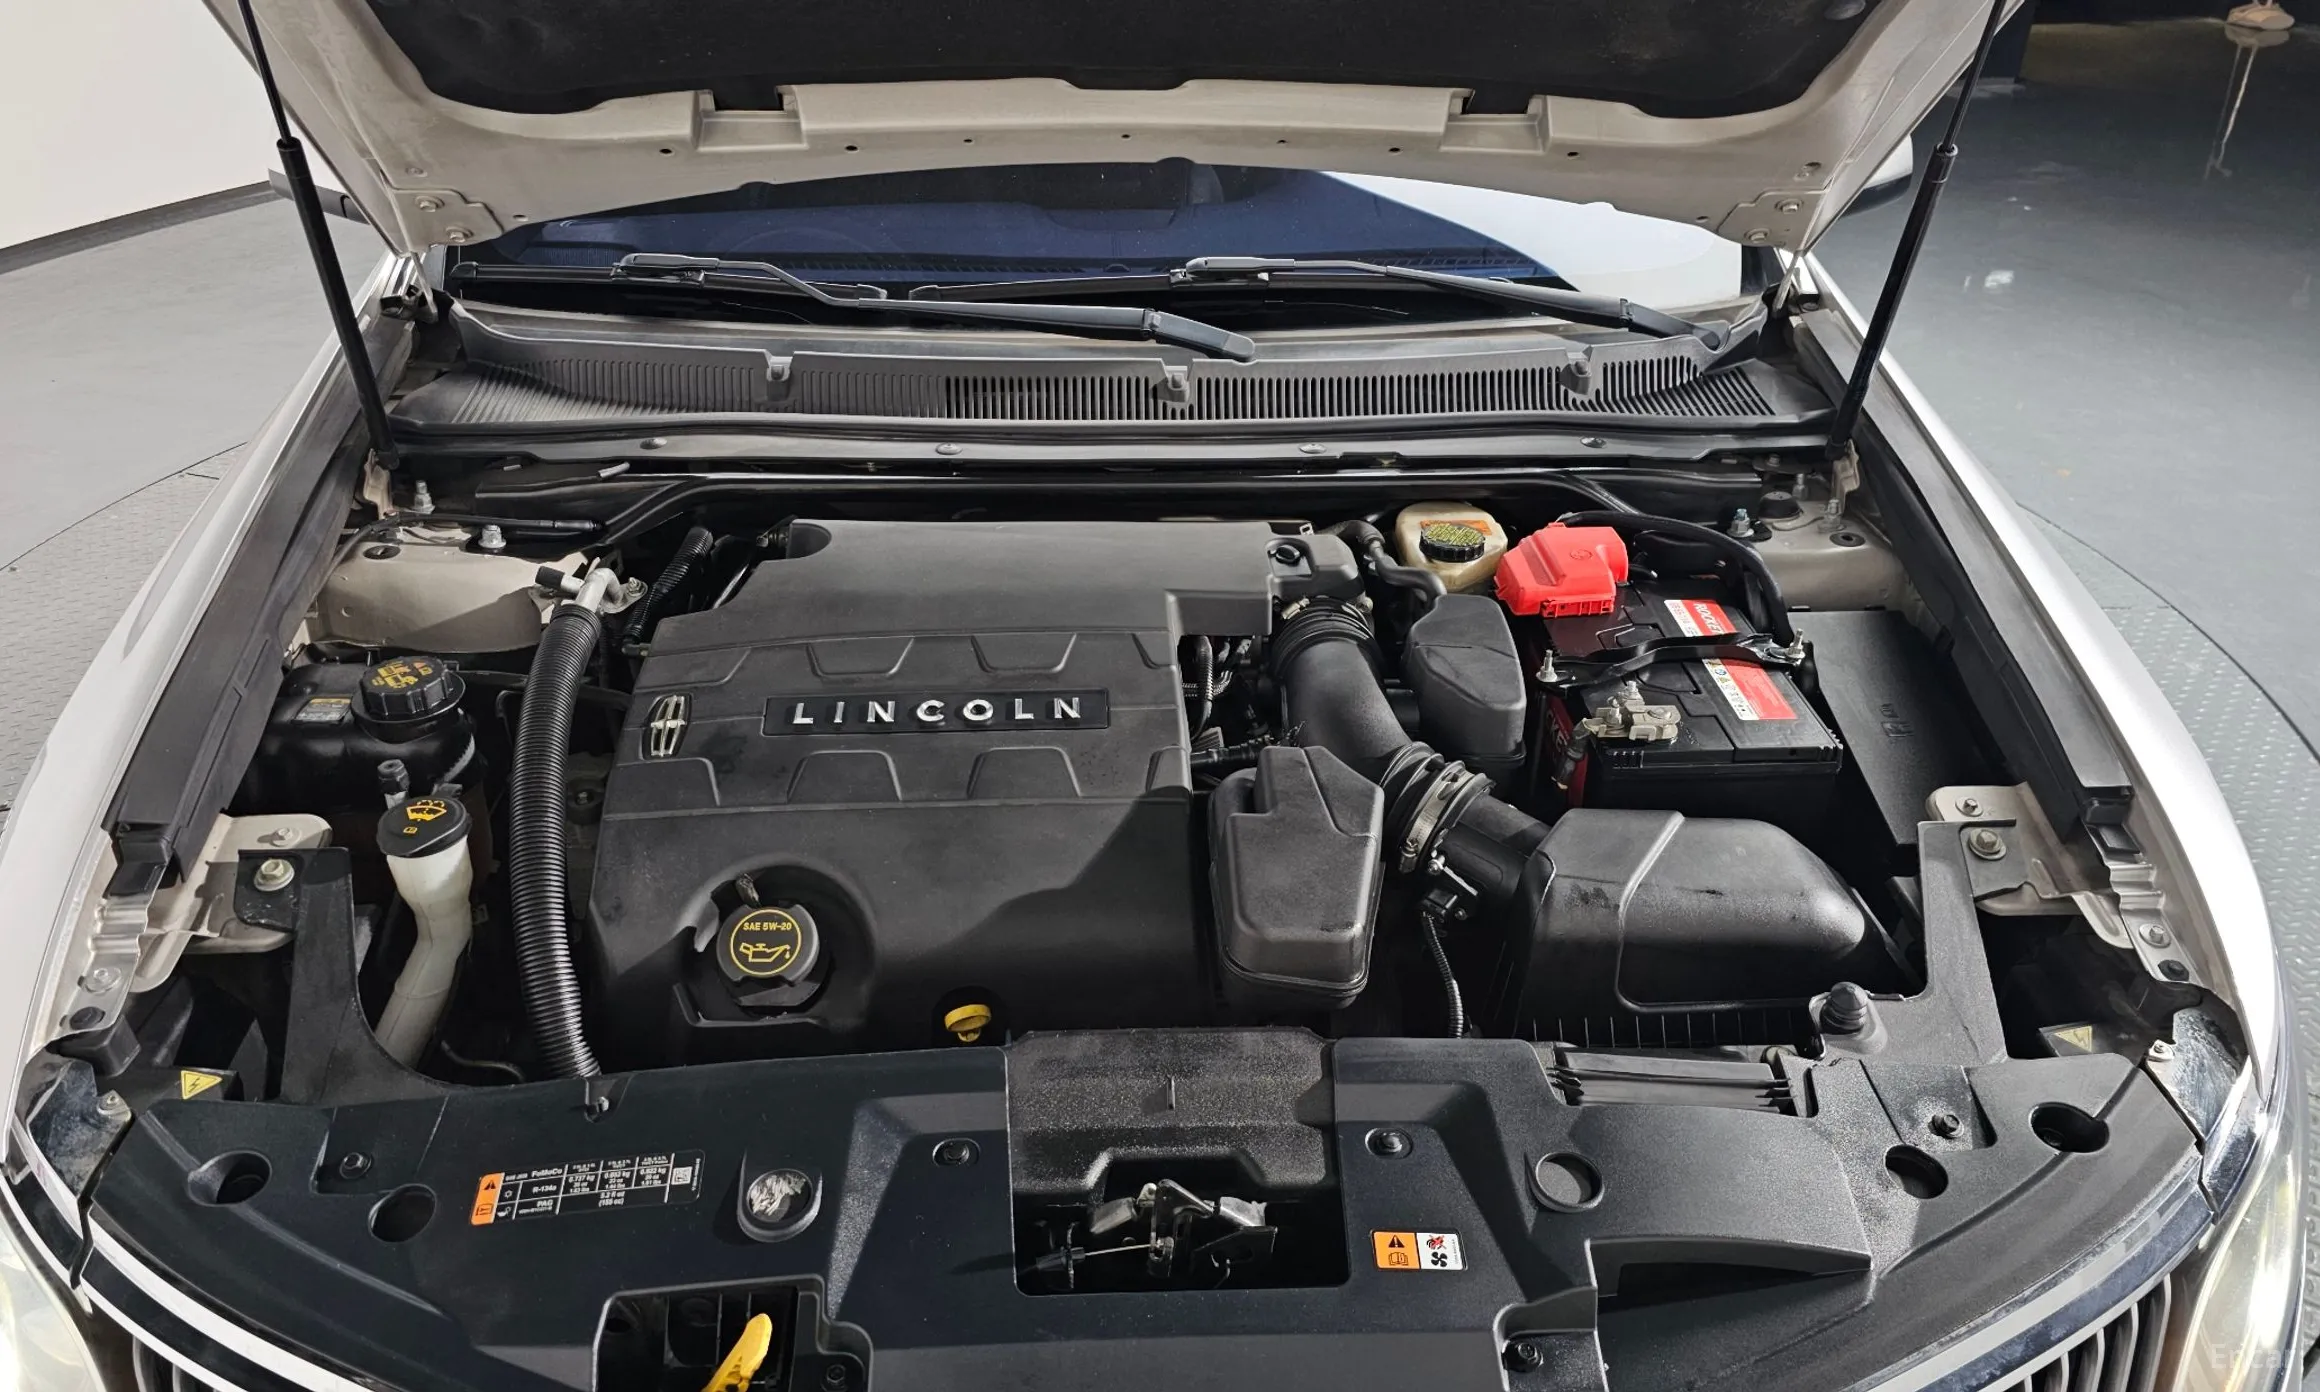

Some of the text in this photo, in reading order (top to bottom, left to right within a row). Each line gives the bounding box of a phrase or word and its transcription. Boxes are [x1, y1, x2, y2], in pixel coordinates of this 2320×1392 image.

[792, 697, 1081, 725] LINCOLN
[742, 922, 792, 931] SAE 5W-20
